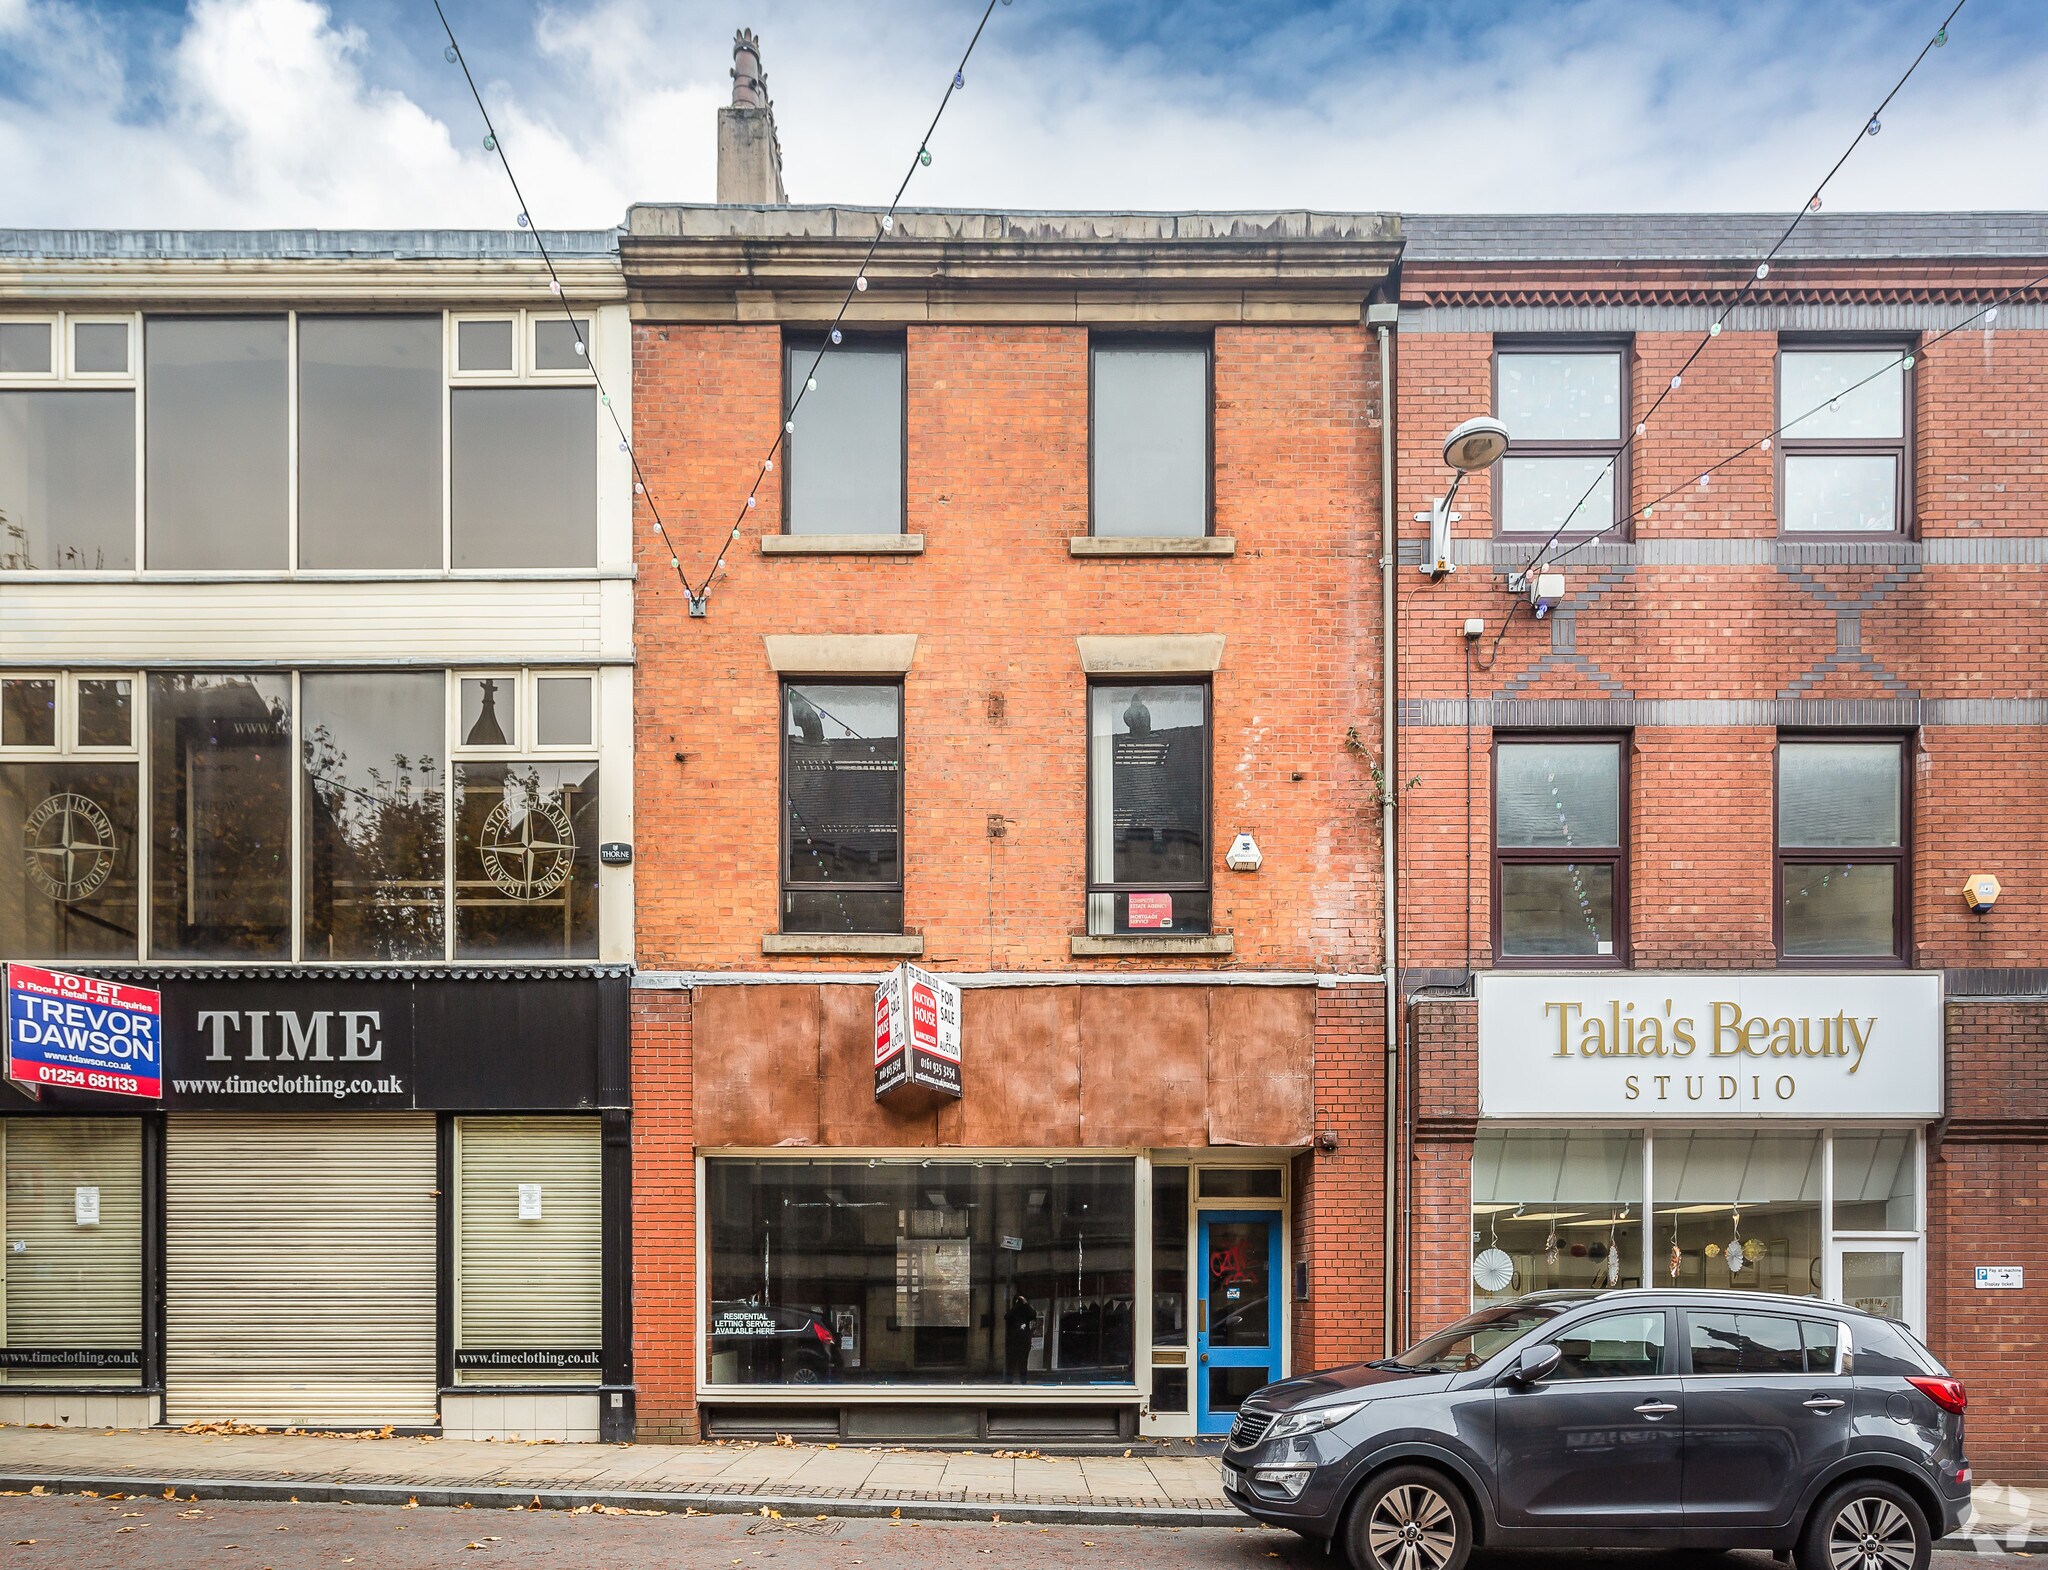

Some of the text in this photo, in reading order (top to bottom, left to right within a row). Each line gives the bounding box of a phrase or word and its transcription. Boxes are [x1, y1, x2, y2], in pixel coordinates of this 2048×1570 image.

[26, 797, 111, 839] STONE ISLAND
[531, 796, 570, 838] ISLAND
[75, 858, 110, 897] STONE
[485, 855, 570, 896] STONE ISLAND
[17, 981, 24, 989] 3
[27, 982, 58, 995] Floors
[61, 989, 87, 1000] Retail
[96, 996, 109, 1005] All
[111, 997, 153, 1012] Enquiries
[51, 973, 122, 998] TO LET
[941, 989, 954, 1007] FOR
[914, 991, 936, 1009] AUCTION
[18, 994, 153, 1039] TREVOR
[914, 1006, 936, 1027] HOUSE
[940, 1007, 955, 1025] SALE
[18, 1019, 154, 1062] DAWSON
[197, 1010, 382, 1062] TIME
[940, 1040, 959, 1056] AUCTION
[1545, 998, 1878, 1074] Talia's Beauty
[44, 1051, 132, 1071] www.tdawson.co.uk
[39, 1066, 138, 1092] 01254 681133
[172, 1075, 404, 1099] www.timeclothing.co.uk
[1625, 1074, 1796, 1101] STUDIO
[1855, 1298, 1888, 1308] OPENING
[0, 1351, 139, 1366] www.timeclothing.co.uk
[459, 1352, 600, 1366] www.timeclothing.co.uk
